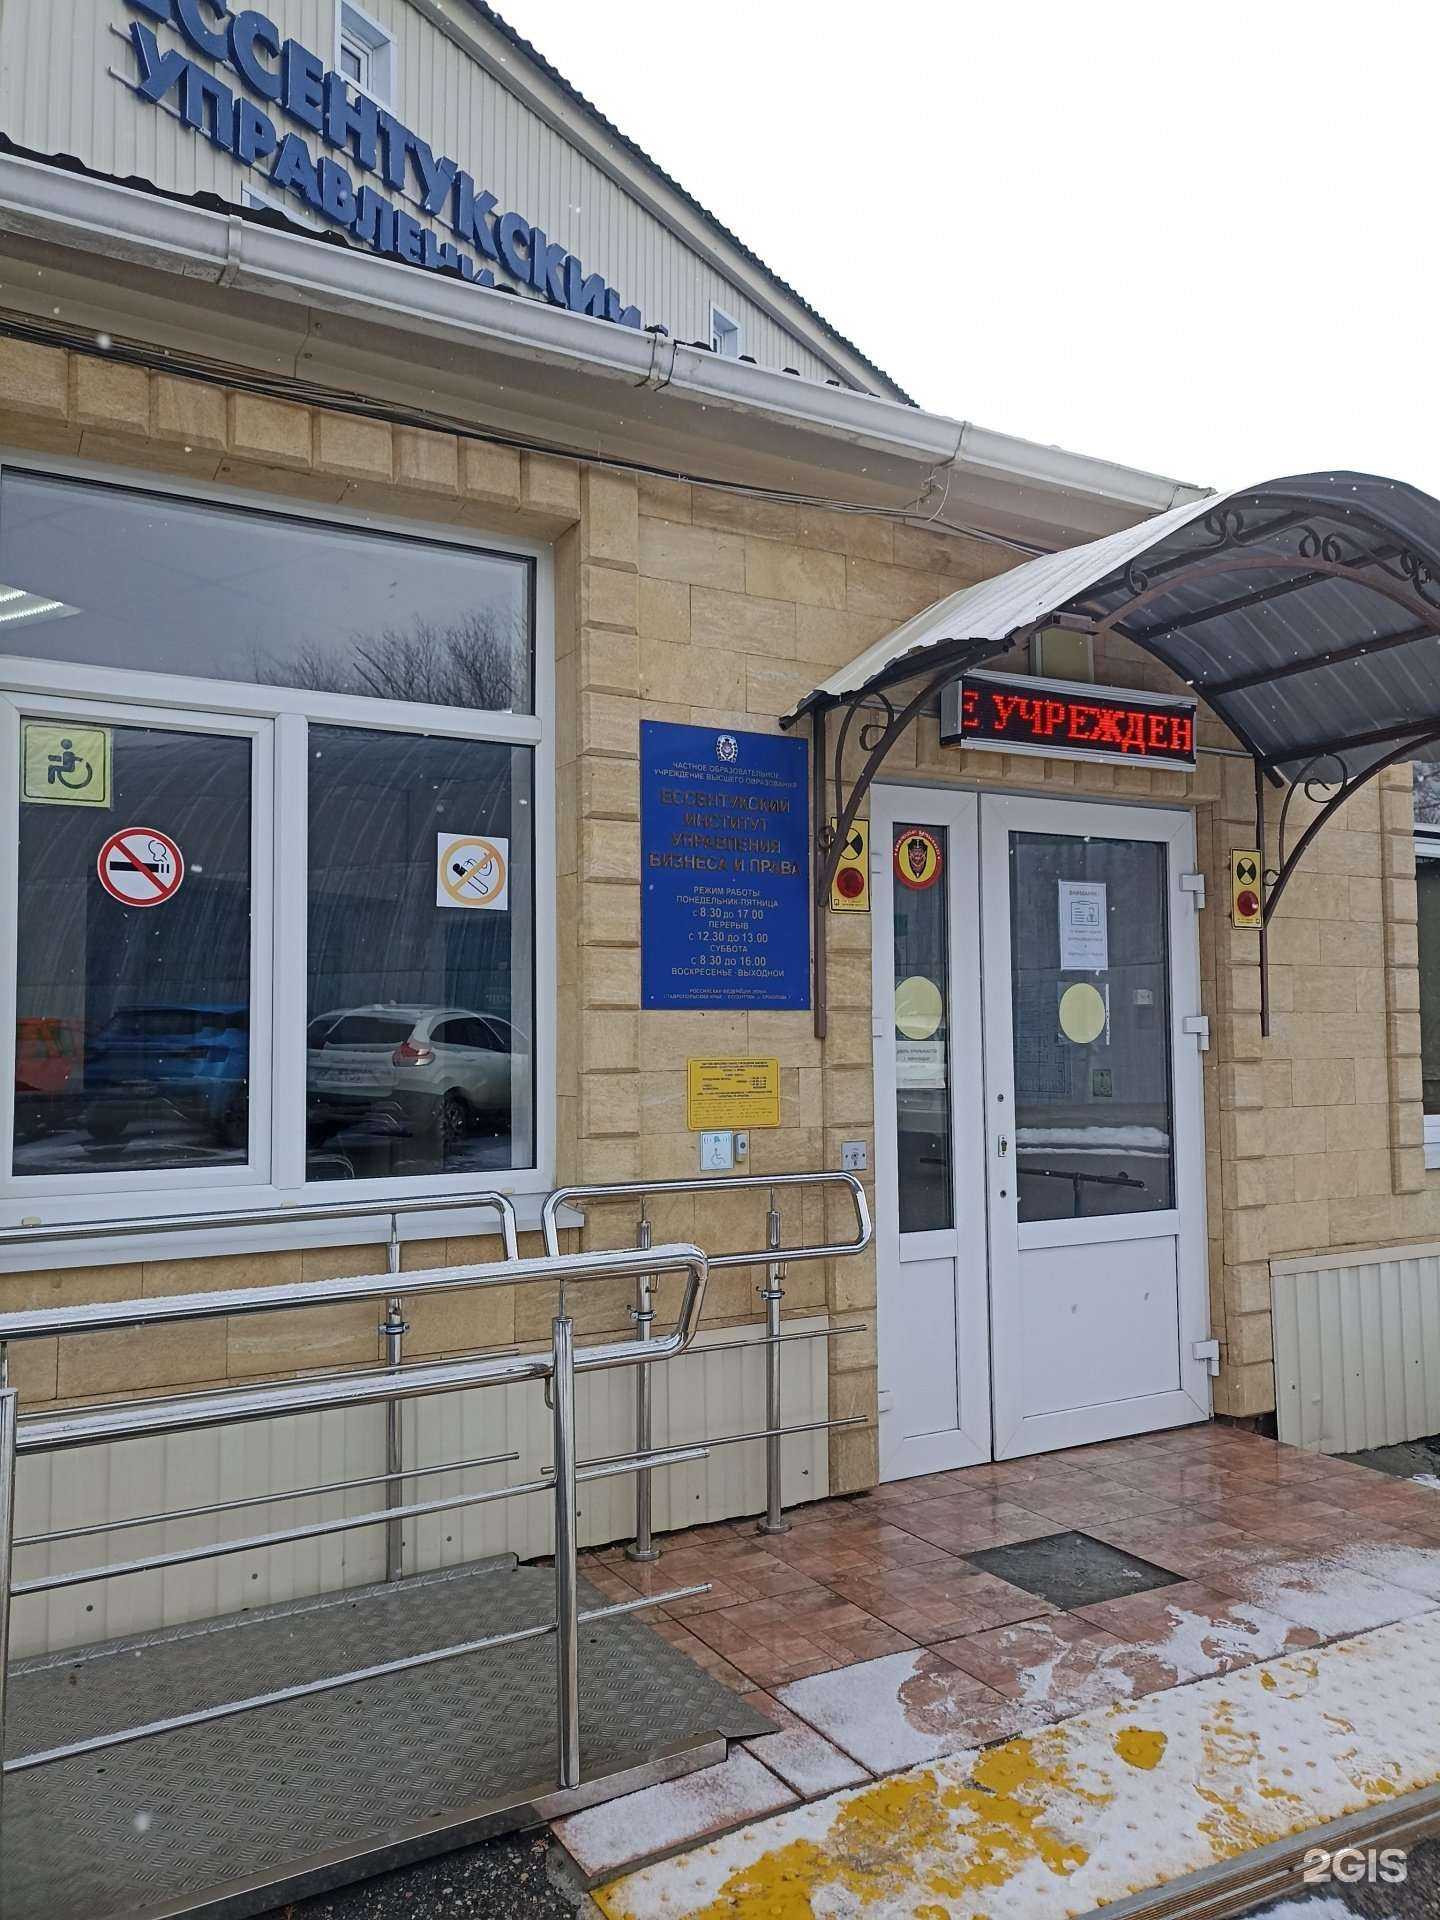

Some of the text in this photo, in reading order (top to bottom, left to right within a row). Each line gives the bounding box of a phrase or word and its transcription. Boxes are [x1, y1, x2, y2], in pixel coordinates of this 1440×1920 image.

[992, 694, 1192, 755] УЧРЕЖДЕН
[672, 761, 707, 772] ЧАСТНОЕ
[654, 769, 704, 780] УЧРЕЖДЕНИЕ
[693, 886, 760, 898] РЕЖИМ РАБОТЫ
[708, 920, 749, 931] ПЕРЕРЫВ
[710, 944, 748, 954] СУББОТА
[671, 967, 733, 977] ВОСКРЕСЕНЬЕ
